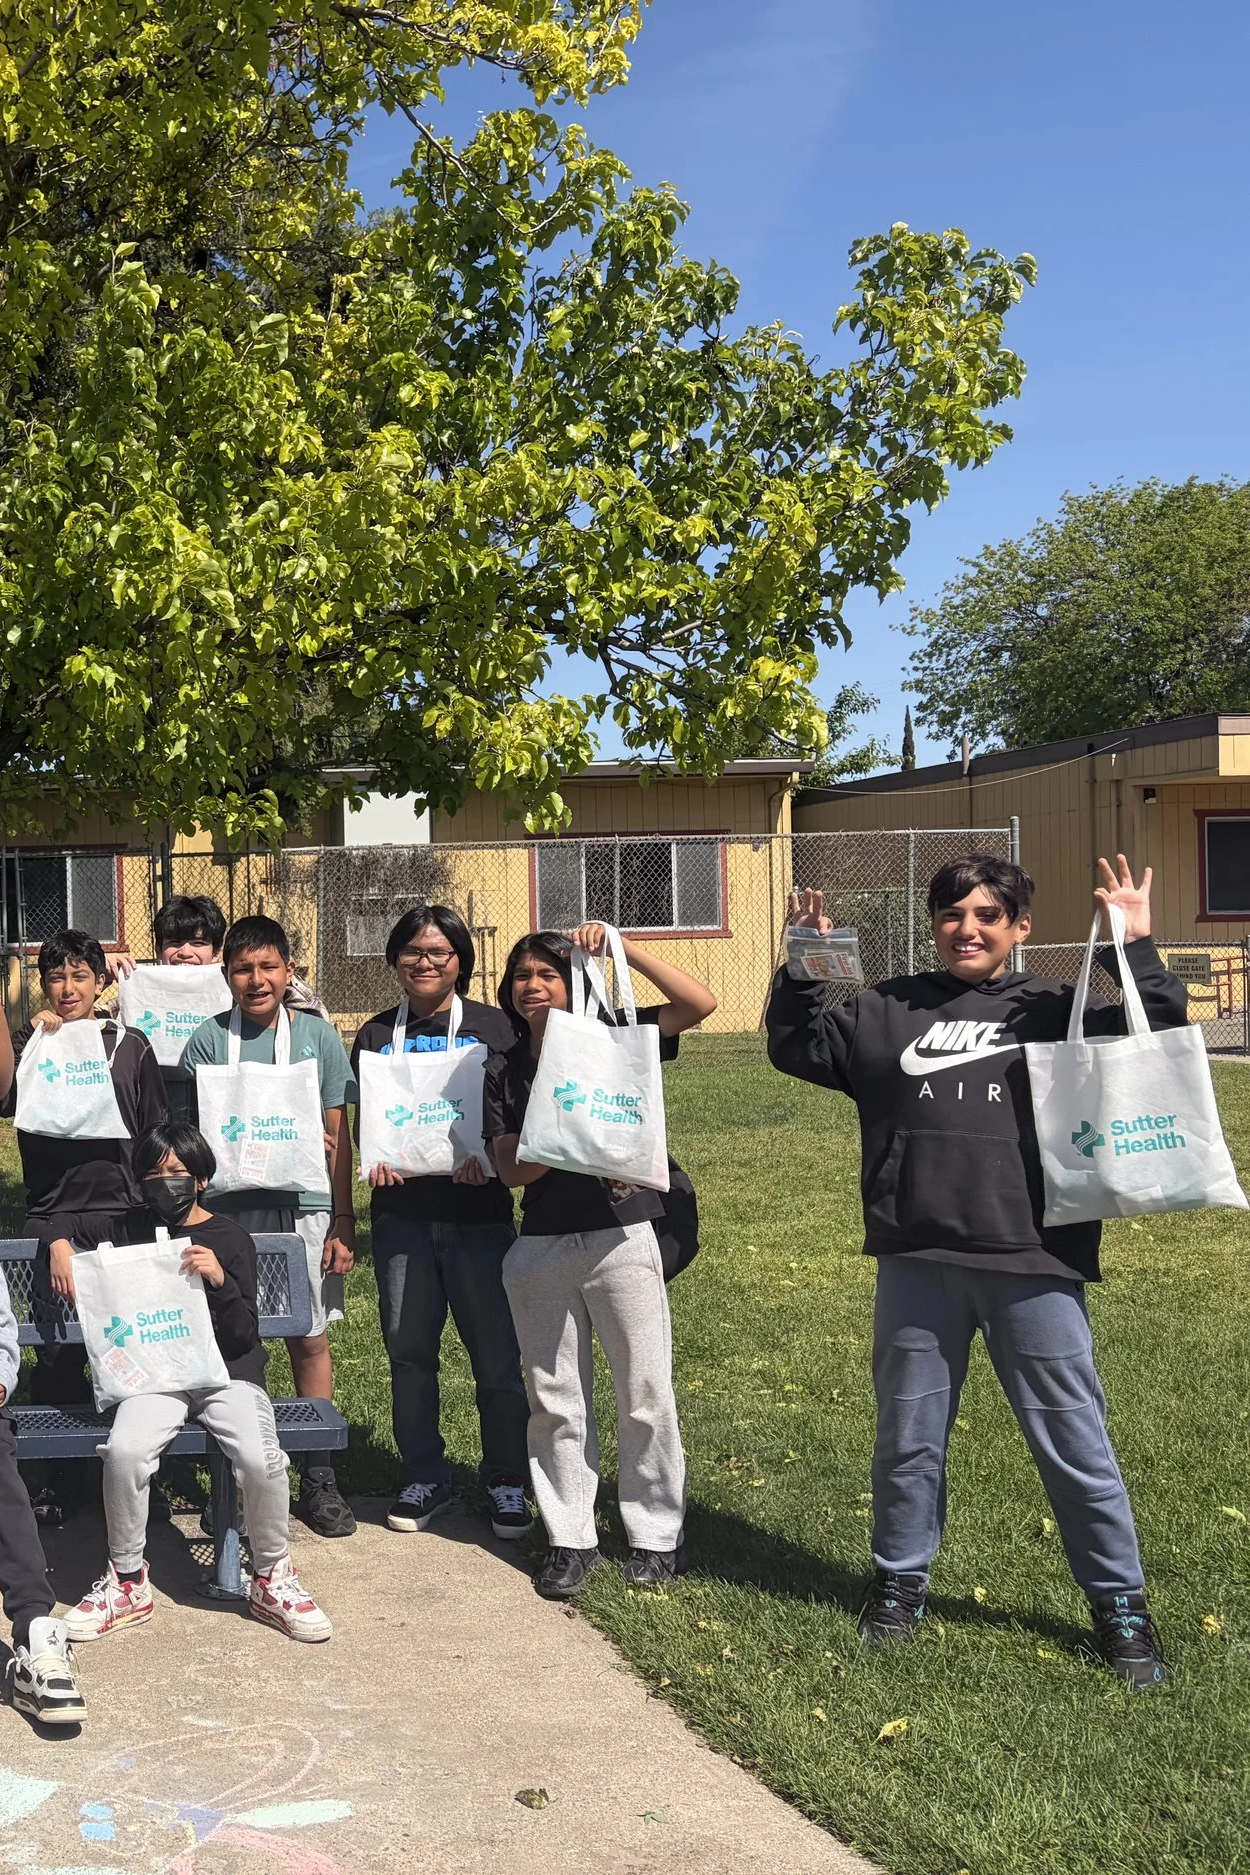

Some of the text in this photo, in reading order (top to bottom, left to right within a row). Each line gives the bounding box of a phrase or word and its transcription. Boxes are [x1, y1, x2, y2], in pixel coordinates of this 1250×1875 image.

[165, 1011, 207, 1025] Sutter
[917, 1020, 1008, 1052] NIKE
[64, 1059, 106, 1074] Sutter
[65, 1072, 110, 1086] Health
[591, 1088, 642, 1108] Sutter
[918, 1080, 1002, 1103] AIR
[418, 1098, 463, 1113] Sutter
[589, 1104, 643, 1126] Health
[250, 1115, 297, 1128] Sutter
[417, 1109, 465, 1126] Health
[1110, 1113, 1177, 1136] Sutter
[251, 1128, 299, 1141] Health
[1113, 1131, 1186, 1157] Health
[135, 1308, 184, 1327] Sutter
[139, 1323, 191, 1345] Health
